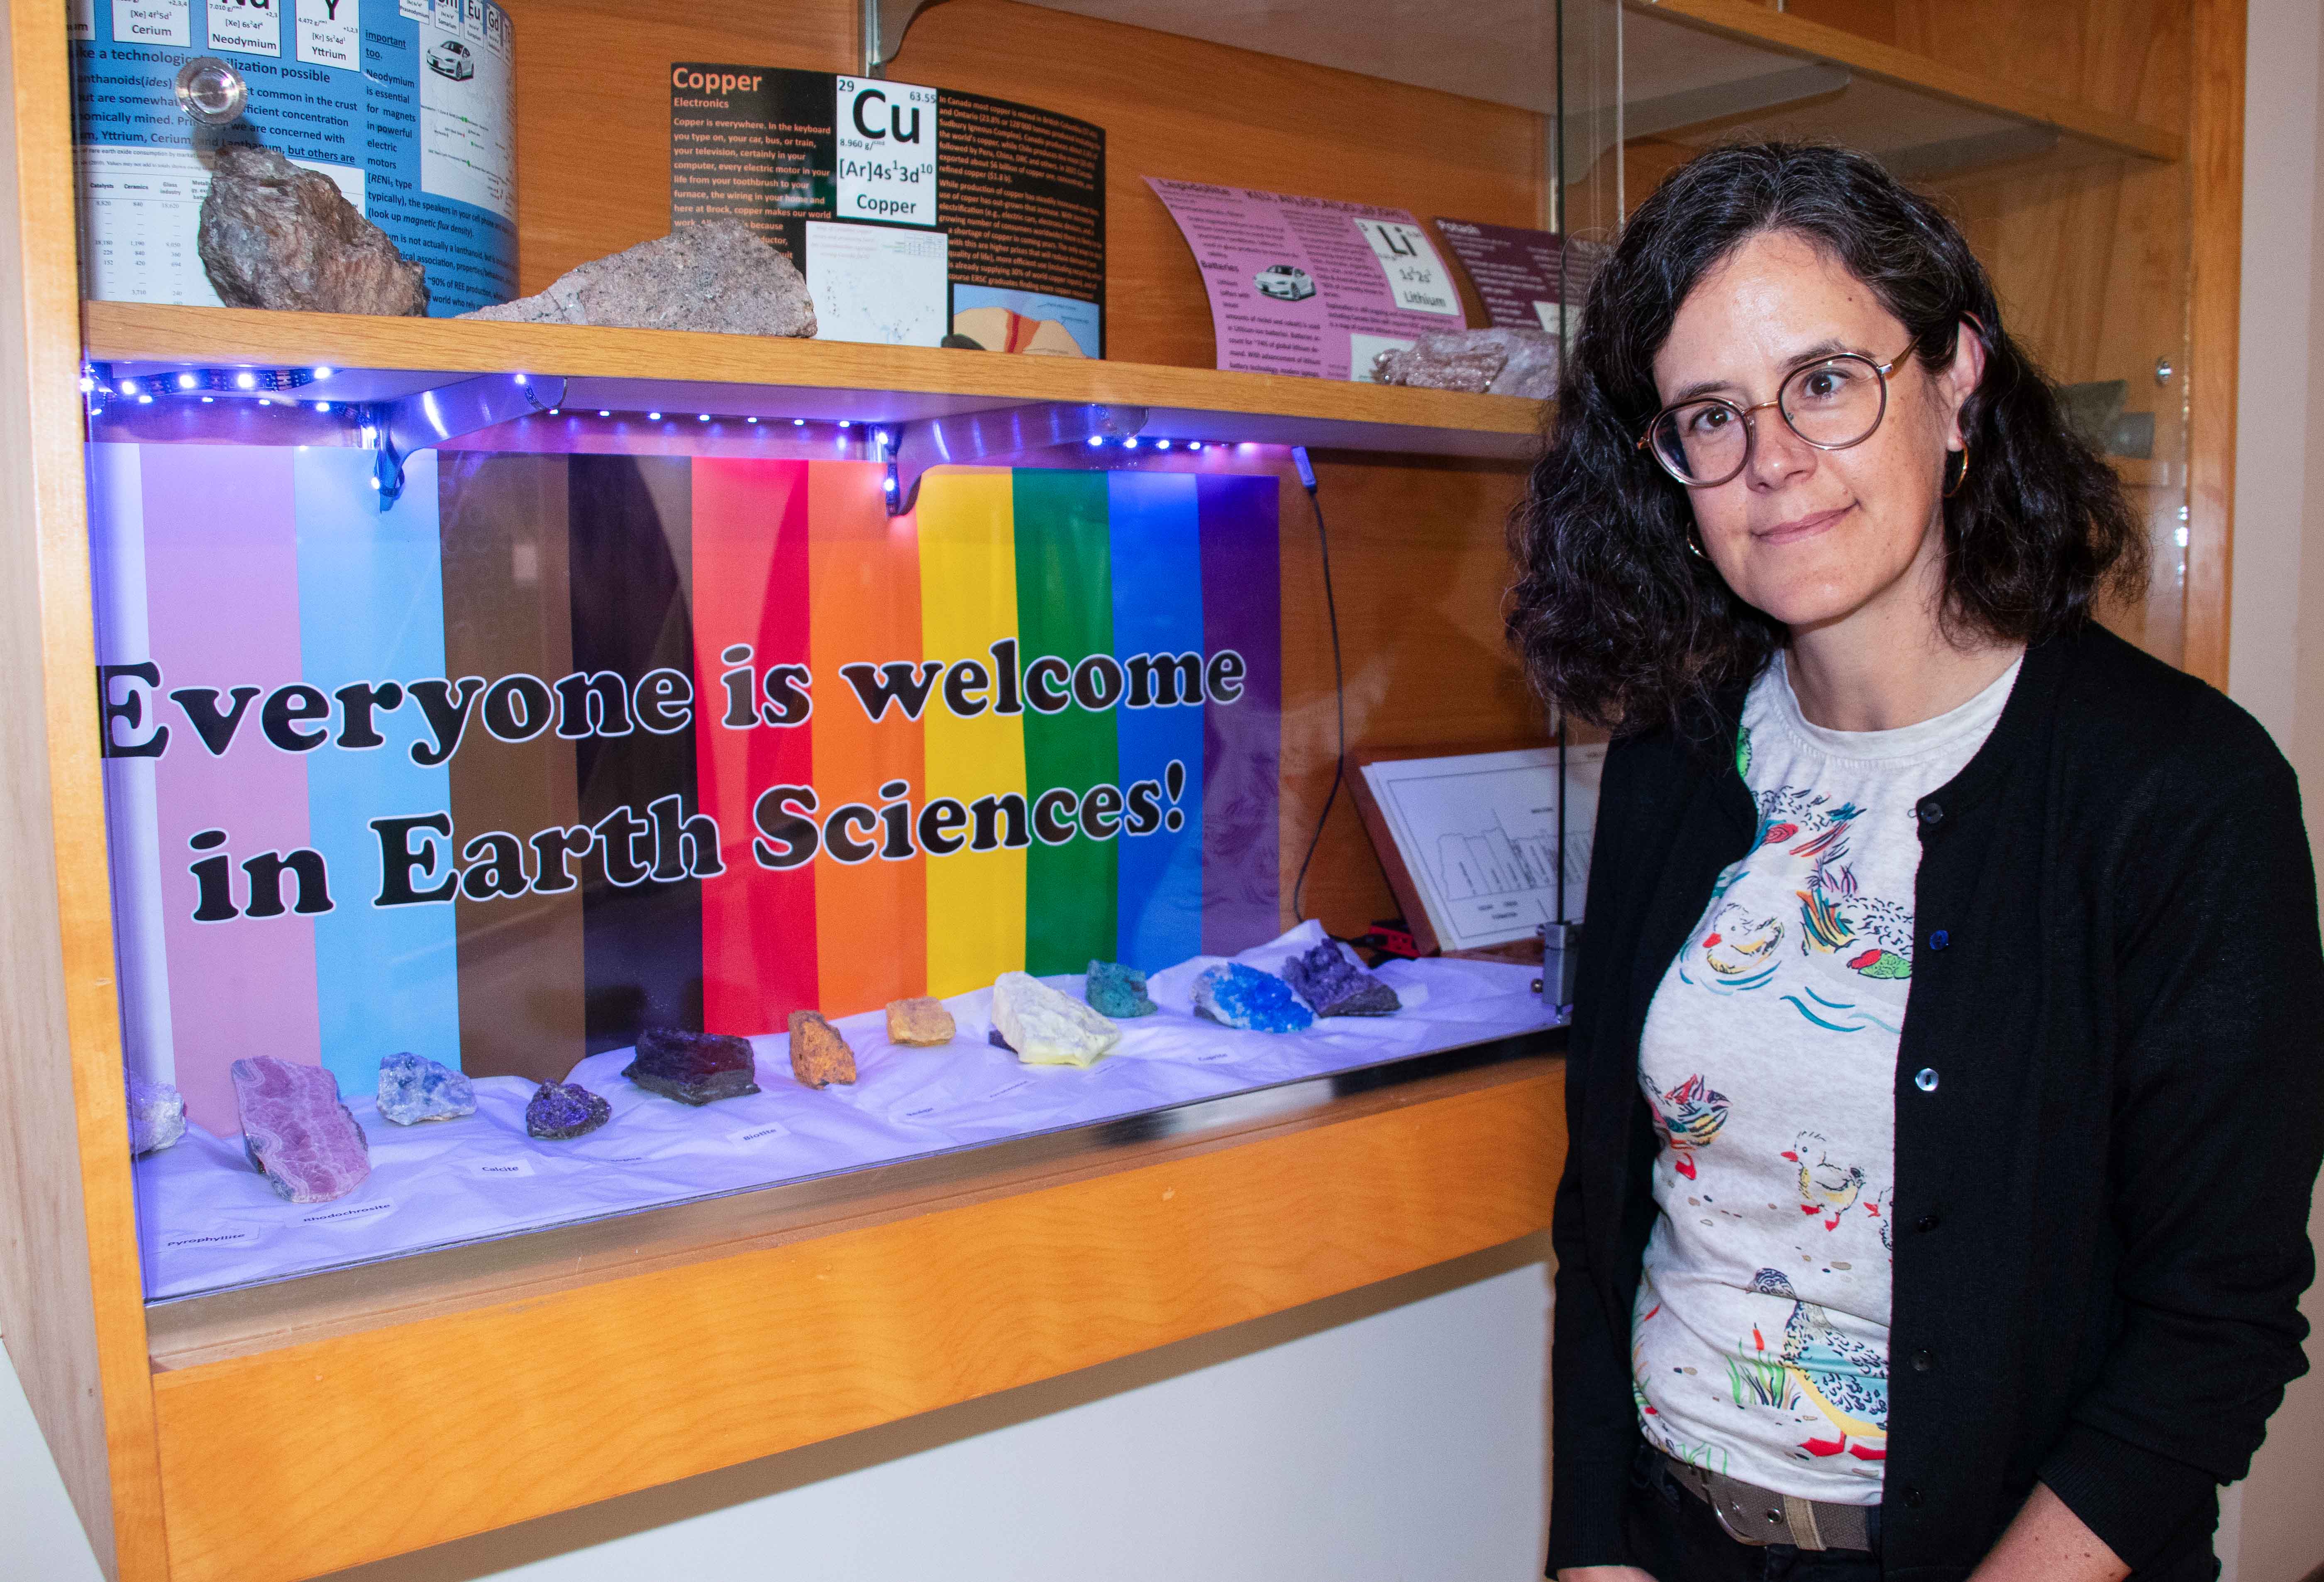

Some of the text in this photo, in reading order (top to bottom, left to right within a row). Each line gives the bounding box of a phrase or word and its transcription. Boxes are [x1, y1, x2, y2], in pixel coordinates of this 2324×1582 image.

[469, 1, 480, 20] Eu
[132, 25, 172, 36] Cerium
[366, 29, 406, 47] important
[213, 33, 277, 49] Neodymium
[312, 46, 347, 60] Yttrium
[366, 48, 382, 59] too.
[100, 50, 107, 59] a
[282, 67, 330, 83] possible
[366, 68, 415, 88] Neodymium
[673, 67, 762, 95] Copper
[838, 79, 854, 92] 29
[98, 95, 180, 107] are somewhat
[257, 89, 358, 111] common in the crust
[366, 86, 410, 104] is essential
[674, 97, 729, 108] Electronics
[909, 91, 936, 104] 63.55
[135, 115, 173, 125] mined.
[283, 110, 349, 127] concentration
[367, 104, 416, 122] for magnets
[852, 88, 920, 144] Cu
[367, 121, 412, 138] in powerful
[674, 118, 704, 127] Copper
[715, 120, 766, 129] everywhere.
[779, 122, 792, 130] the
[794, 124, 830, 134] keyboard
[102, 131, 147, 143] Yttrium,
[251, 125, 266, 133] are
[270, 127, 322, 140] concerned
[325, 134, 345, 144] with
[692, 133, 710, 142] type
[765, 136, 782, 145] bus,
[795, 138, 816, 148] train,
[367, 139, 397, 152] electric
[840, 139, 862, 148] 8.960
[288, 145, 305, 156] but
[308, 148, 338, 161] others
[341, 154, 355, 163] are
[695, 147, 737, 157] television,
[740, 149, 775, 159] certainly
[368, 157, 396, 169] motors
[674, 162, 716, 171] computer,
[719, 163, 742, 171] every
[743, 163, 773, 172] electric
[395, 179, 412, 190] type
[689, 175, 709, 183] from
[733, 177, 779, 187] toothbrush
[674, 189, 709, 199] furnace,
[710, 190, 724, 198] the
[727, 191, 753, 202] wiring
[785, 194, 807, 203] home
[368, 191, 471, 220] typically), the speakers in your
[674, 204, 693, 212] here
[706, 205, 732, 214] Brock,
[734, 207, 762, 215] copper
[764, 208, 791, 216] makes
[857, 193, 916, 215] Copper
[369, 207, 389, 219] (look
[391, 214, 401, 223] up
[403, 215, 436, 227] magnetic
[437, 220, 449, 231] flux
[750, 221, 784, 229] because
[401, 234, 406, 243] is
[409, 237, 421, 245] not
[423, 239, 448, 252] actually
[1377, 225, 1418, 256] Li
[417, 256, 455, 271] association,
[447, 280, 453, 288] of
[455, 281, 465, 291] REE
[433, 295, 476, 310] world who rely
[1404, 291, 1446, 307] Lithium
[99, 637, 1247, 769] Everyone is welcome
[188, 759, 1186, 924] in Earth Sciences!
[743, 1129, 776, 1140] Biotite
[303, 1204, 391, 1222] Rhodochrosite
[167, 1233, 245, 1246] Pyrophyllite
